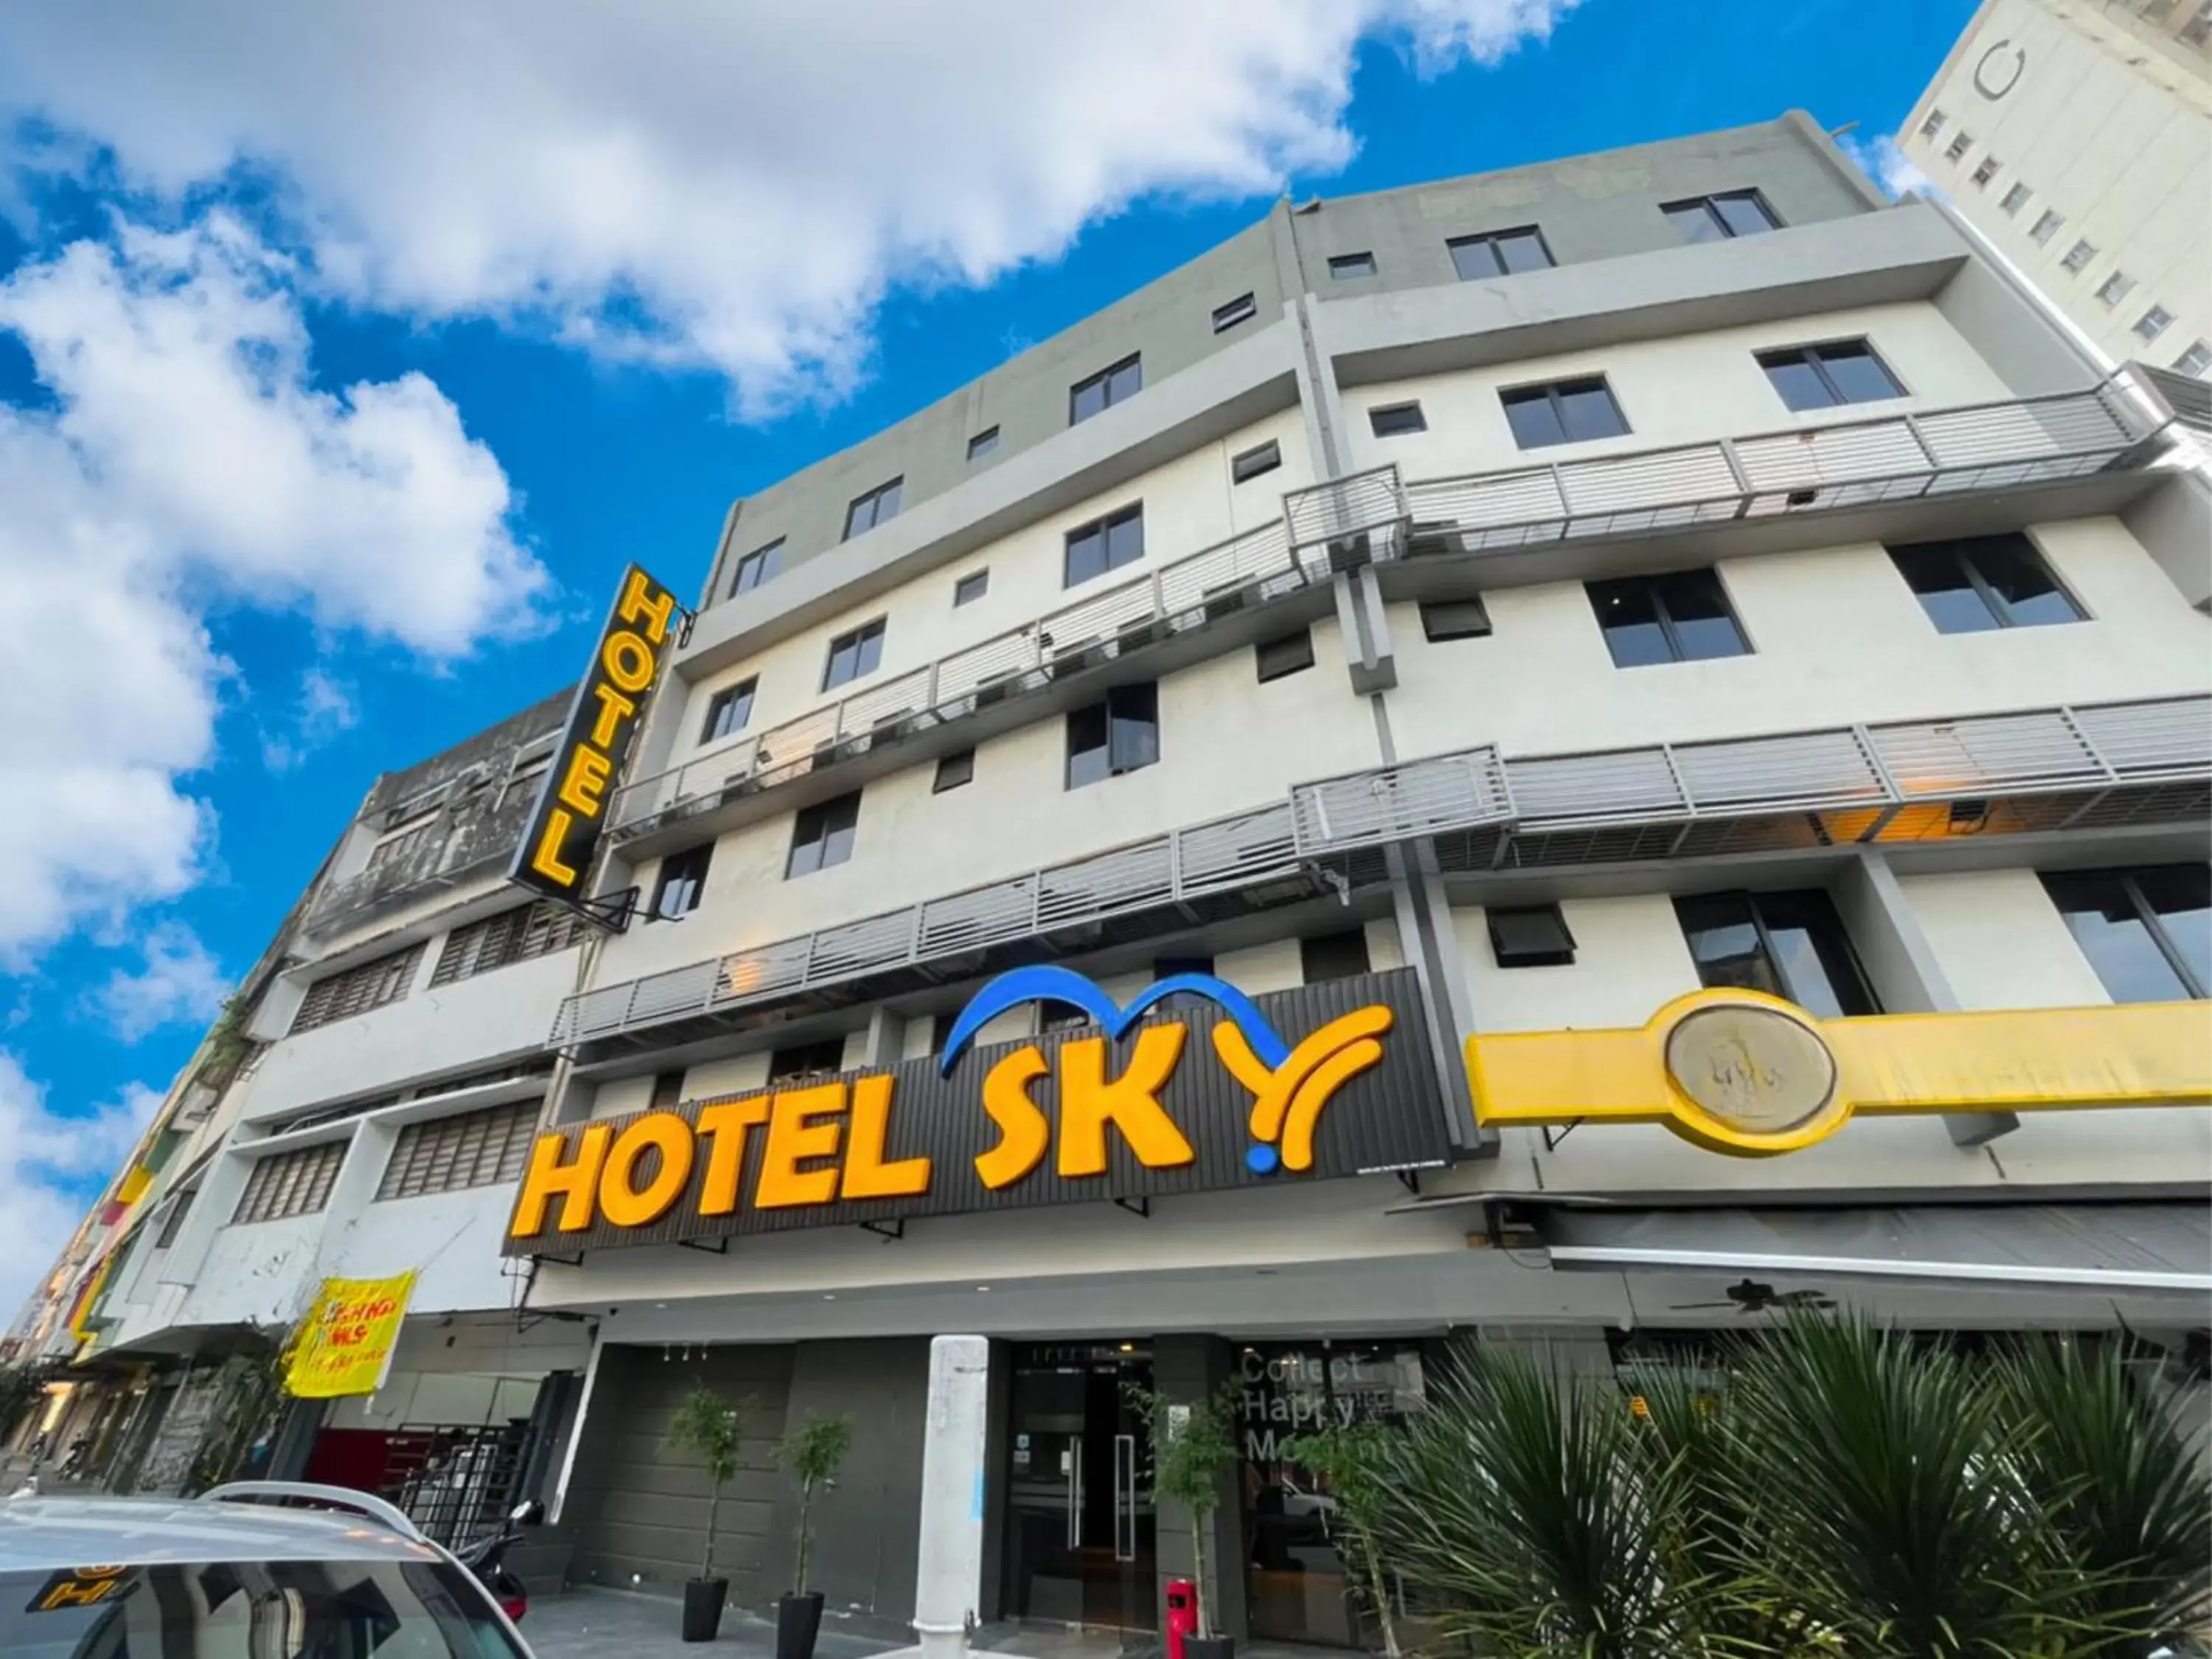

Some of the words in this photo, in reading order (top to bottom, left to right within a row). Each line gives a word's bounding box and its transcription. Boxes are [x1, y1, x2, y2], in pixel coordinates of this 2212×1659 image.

[532, 571, 674, 887] HOTEL
[510, 1073, 931, 1237] HOTEL
[974, 1004, 1393, 1189] SKY
[1242, 1350, 1363, 1382] Collect
